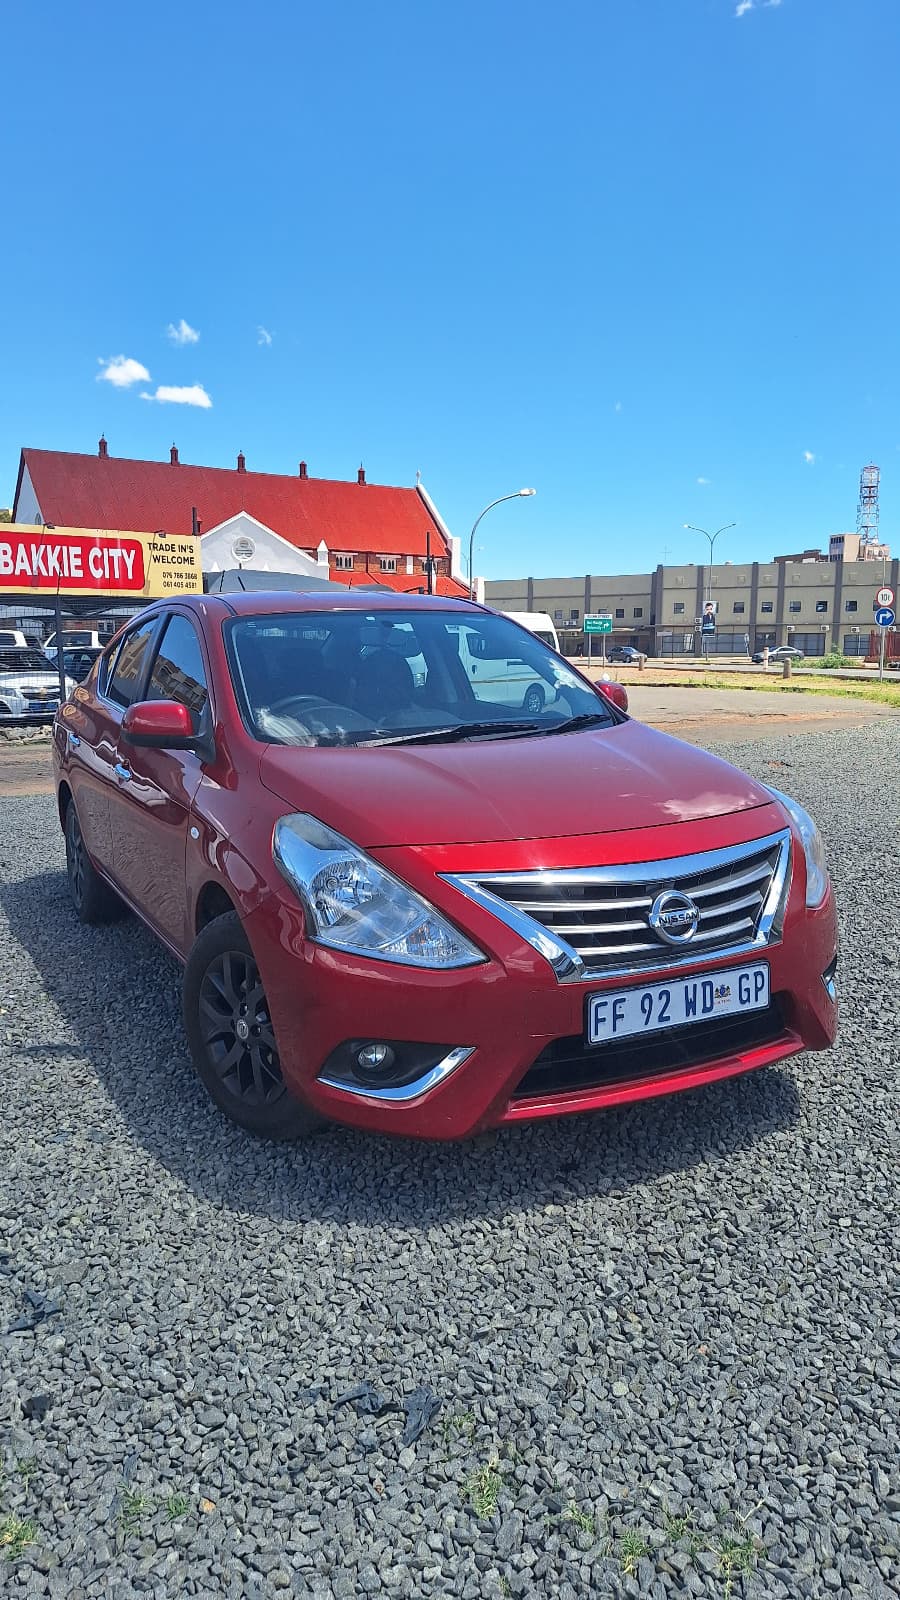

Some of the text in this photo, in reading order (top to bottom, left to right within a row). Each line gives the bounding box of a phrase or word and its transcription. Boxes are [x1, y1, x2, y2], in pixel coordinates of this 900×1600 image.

[147, 542, 194, 554] TRADE IN'S
[0, 542, 136, 579] BAKKIE CITY
[152, 554, 195, 566] WELCOME
[658, 909, 700, 925] NISSAN
[594, 970, 765, 1036] FF 92 WD GP
